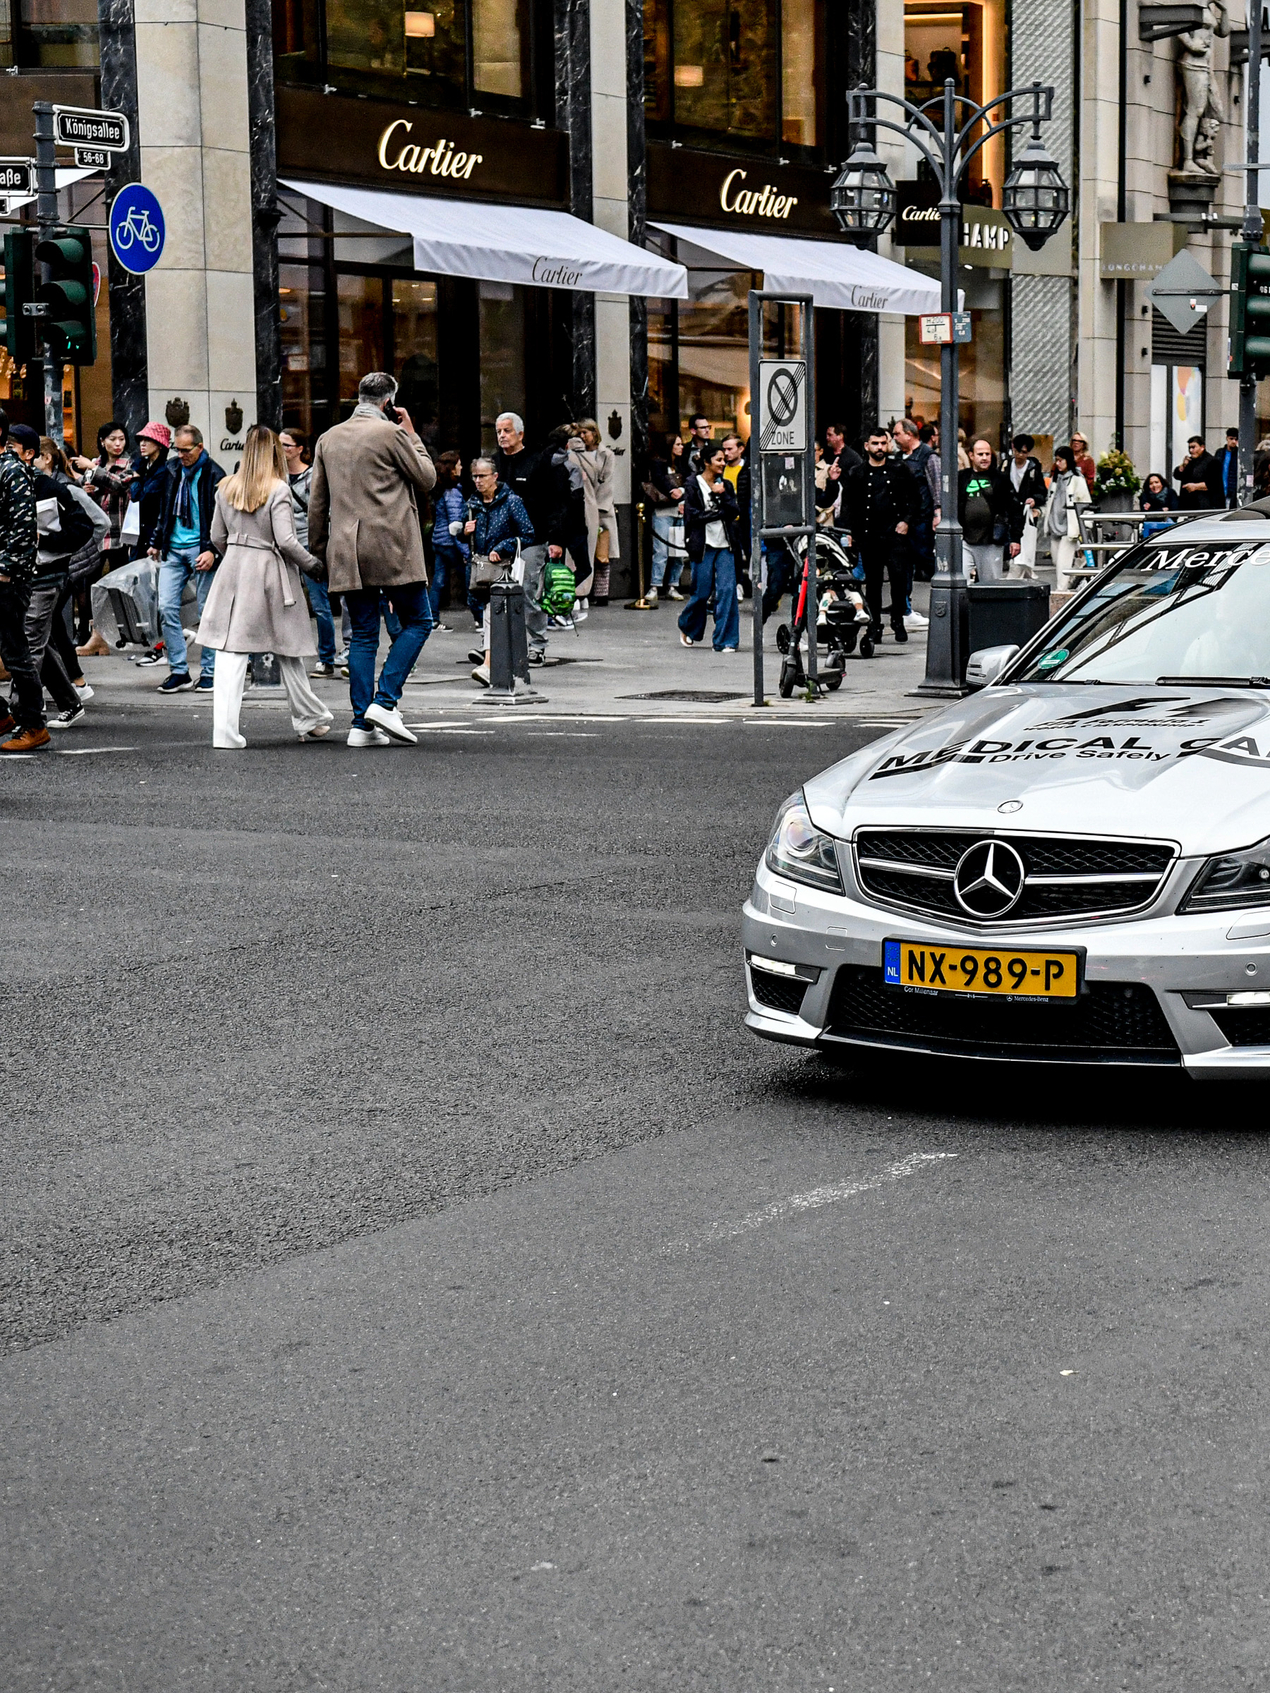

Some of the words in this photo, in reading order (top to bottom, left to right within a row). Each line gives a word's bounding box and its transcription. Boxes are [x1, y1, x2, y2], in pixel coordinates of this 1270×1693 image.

[65, 117, 120, 140] Königsallee
[83, 151, 104, 165] 56-68
[378, 119, 483, 179] Cartier
[720, 168, 798, 219] Cartier
[902, 205, 941, 221] Cartie
[963, 222, 1009, 250] HAMP
[532, 255, 583, 286] Cartier
[851, 284, 888, 309] Cartier
[771, 431, 795, 445] ZONE
[876, 736, 1153, 771] MEDICAL
[989, 750, 1064, 764] Drive
[1075, 750, 1171, 762] Safely
[887, 967, 898, 977] NL
[908, 949, 1064, 991] NX-989-P
[903, 985, 913, 993] Cor
[1014, 995, 1049, 1003] Mercedes-Benz
